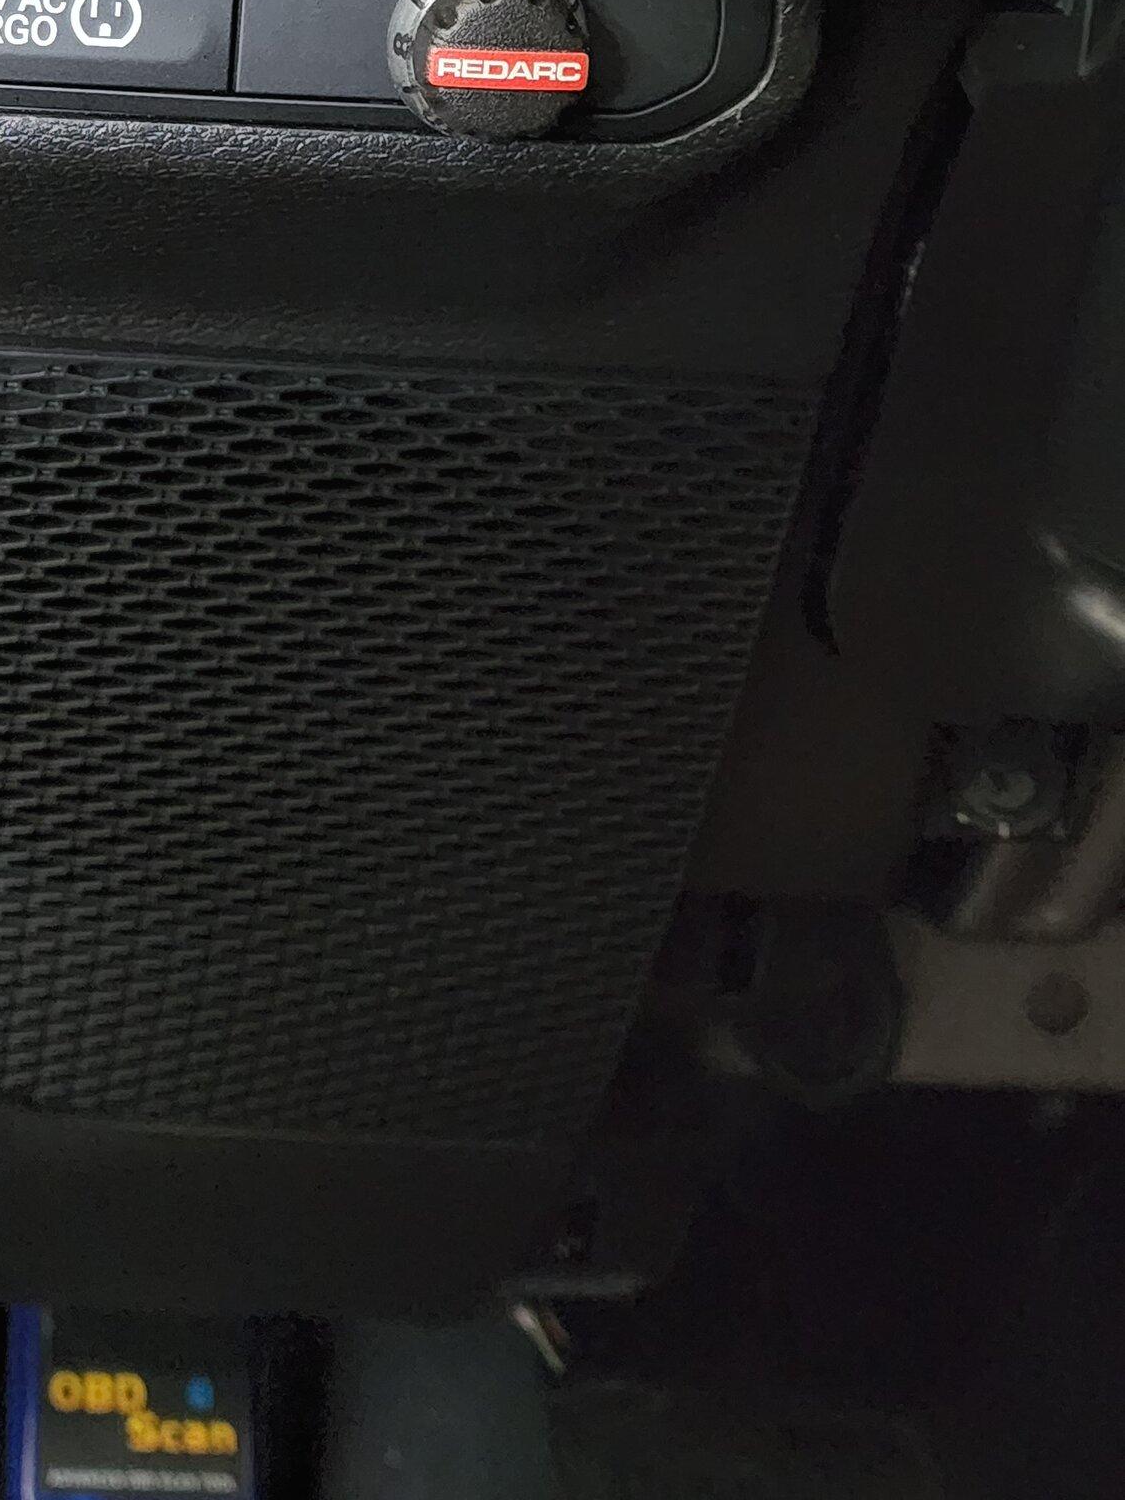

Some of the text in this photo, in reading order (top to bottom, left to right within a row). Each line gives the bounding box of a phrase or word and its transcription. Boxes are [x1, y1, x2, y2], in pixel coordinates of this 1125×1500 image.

[437, 57, 582, 82] REDARC
[48, 1370, 148, 1415] OBD
[126, 1410, 238, 1455] Scan
